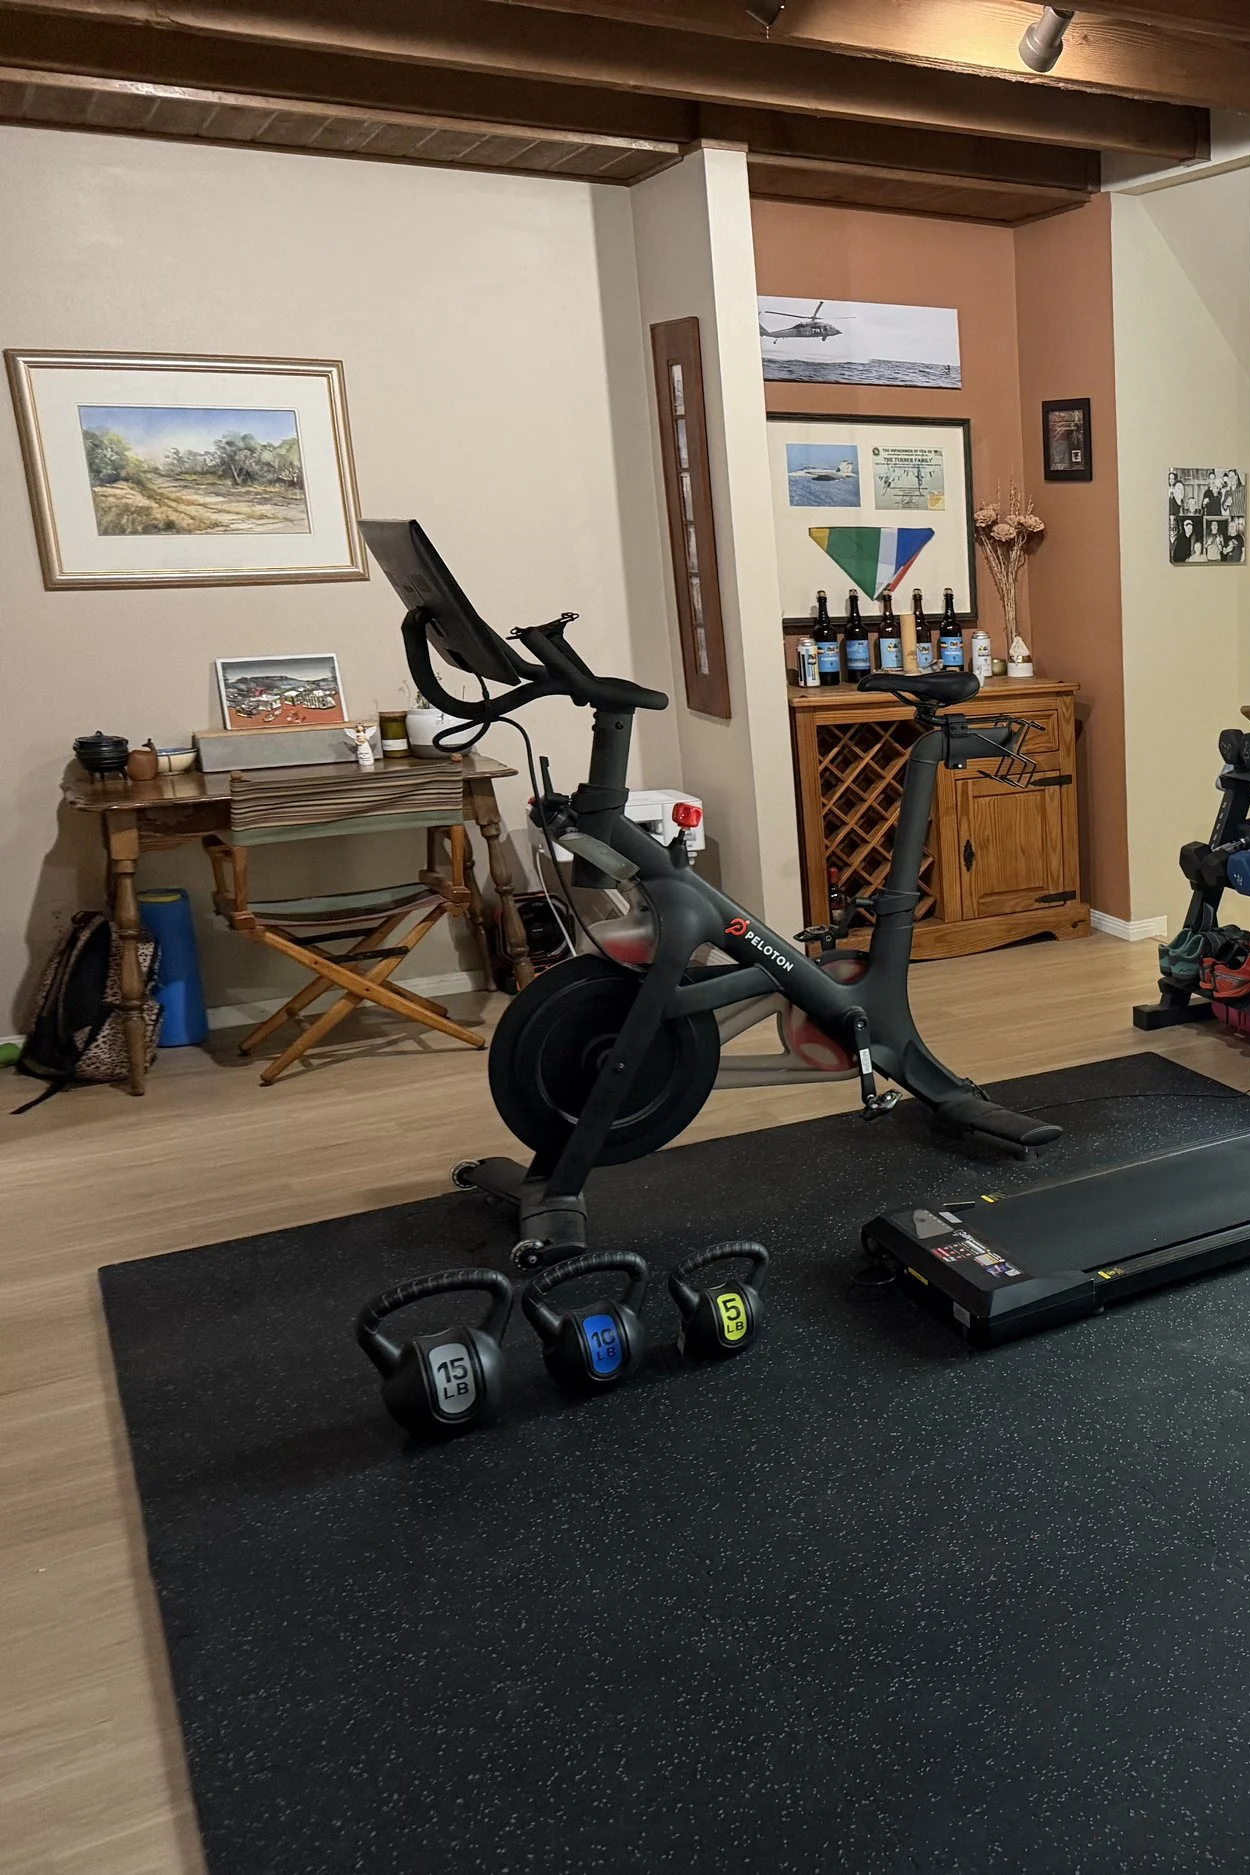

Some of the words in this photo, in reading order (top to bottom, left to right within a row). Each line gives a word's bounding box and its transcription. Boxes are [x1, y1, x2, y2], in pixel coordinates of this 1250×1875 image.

[744, 931, 794, 972] PELOTON
[721, 1297, 742, 1321] 5
[726, 1320, 744, 1334] LB
[591, 1328, 616, 1348] 10
[596, 1346, 617, 1361] LB
[437, 1356, 468, 1383] 15
[443, 1381, 470, 1400] LB
